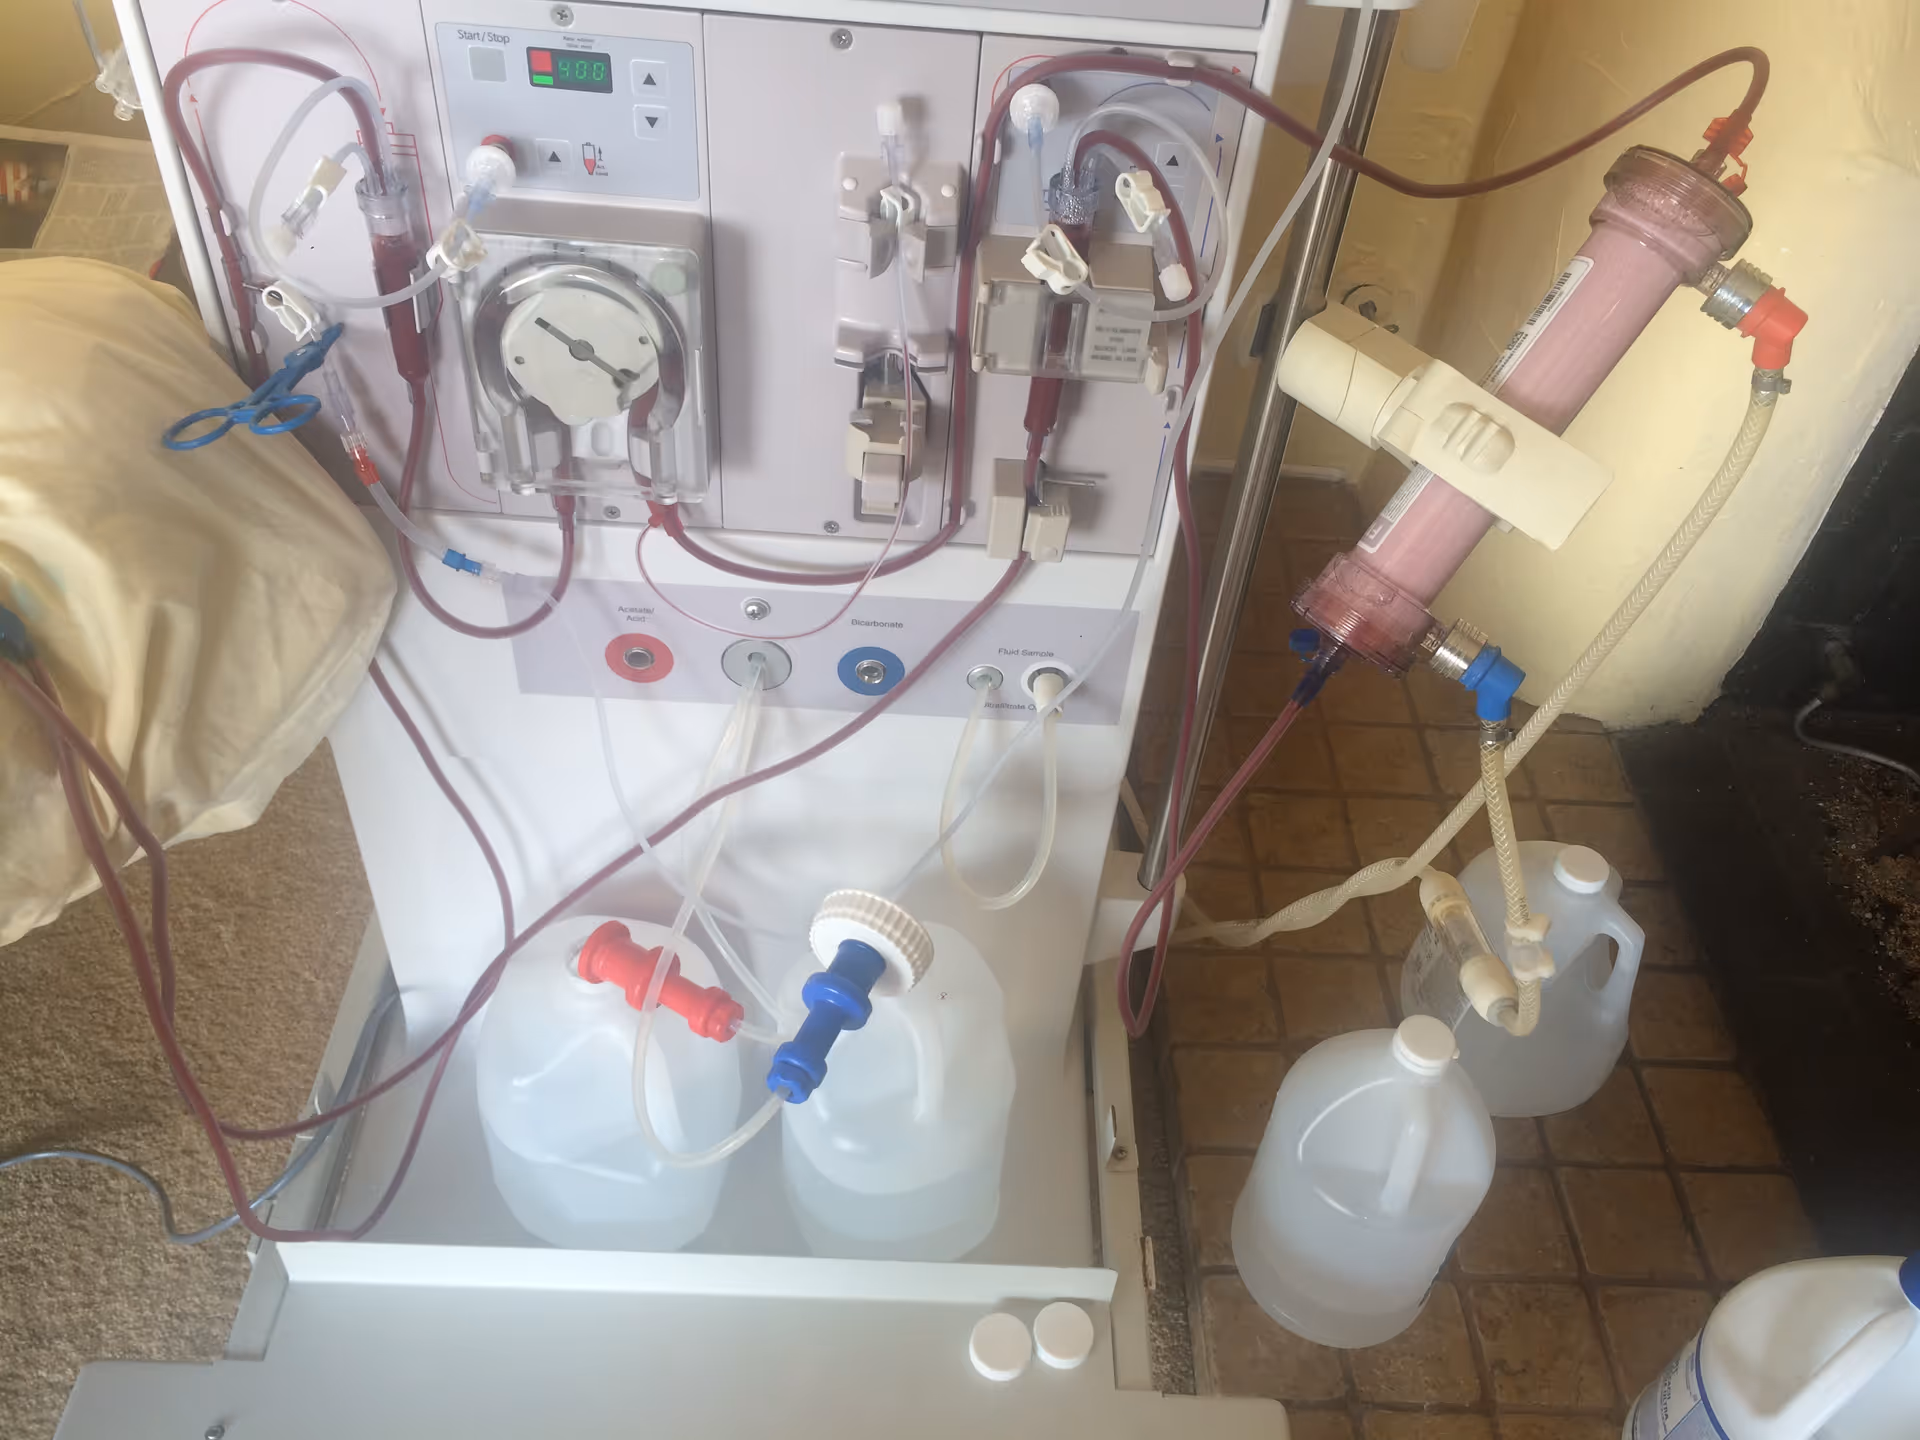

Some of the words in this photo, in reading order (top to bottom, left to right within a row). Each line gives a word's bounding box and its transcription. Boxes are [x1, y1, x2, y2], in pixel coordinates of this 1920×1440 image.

[457, 29, 481, 41] Start
[487, 31, 510, 45] Stop
[851, 618, 904, 629] Bicarbonate
[998, 647, 1020, 656] Fluid
[1021, 648, 1055, 658] Sample
